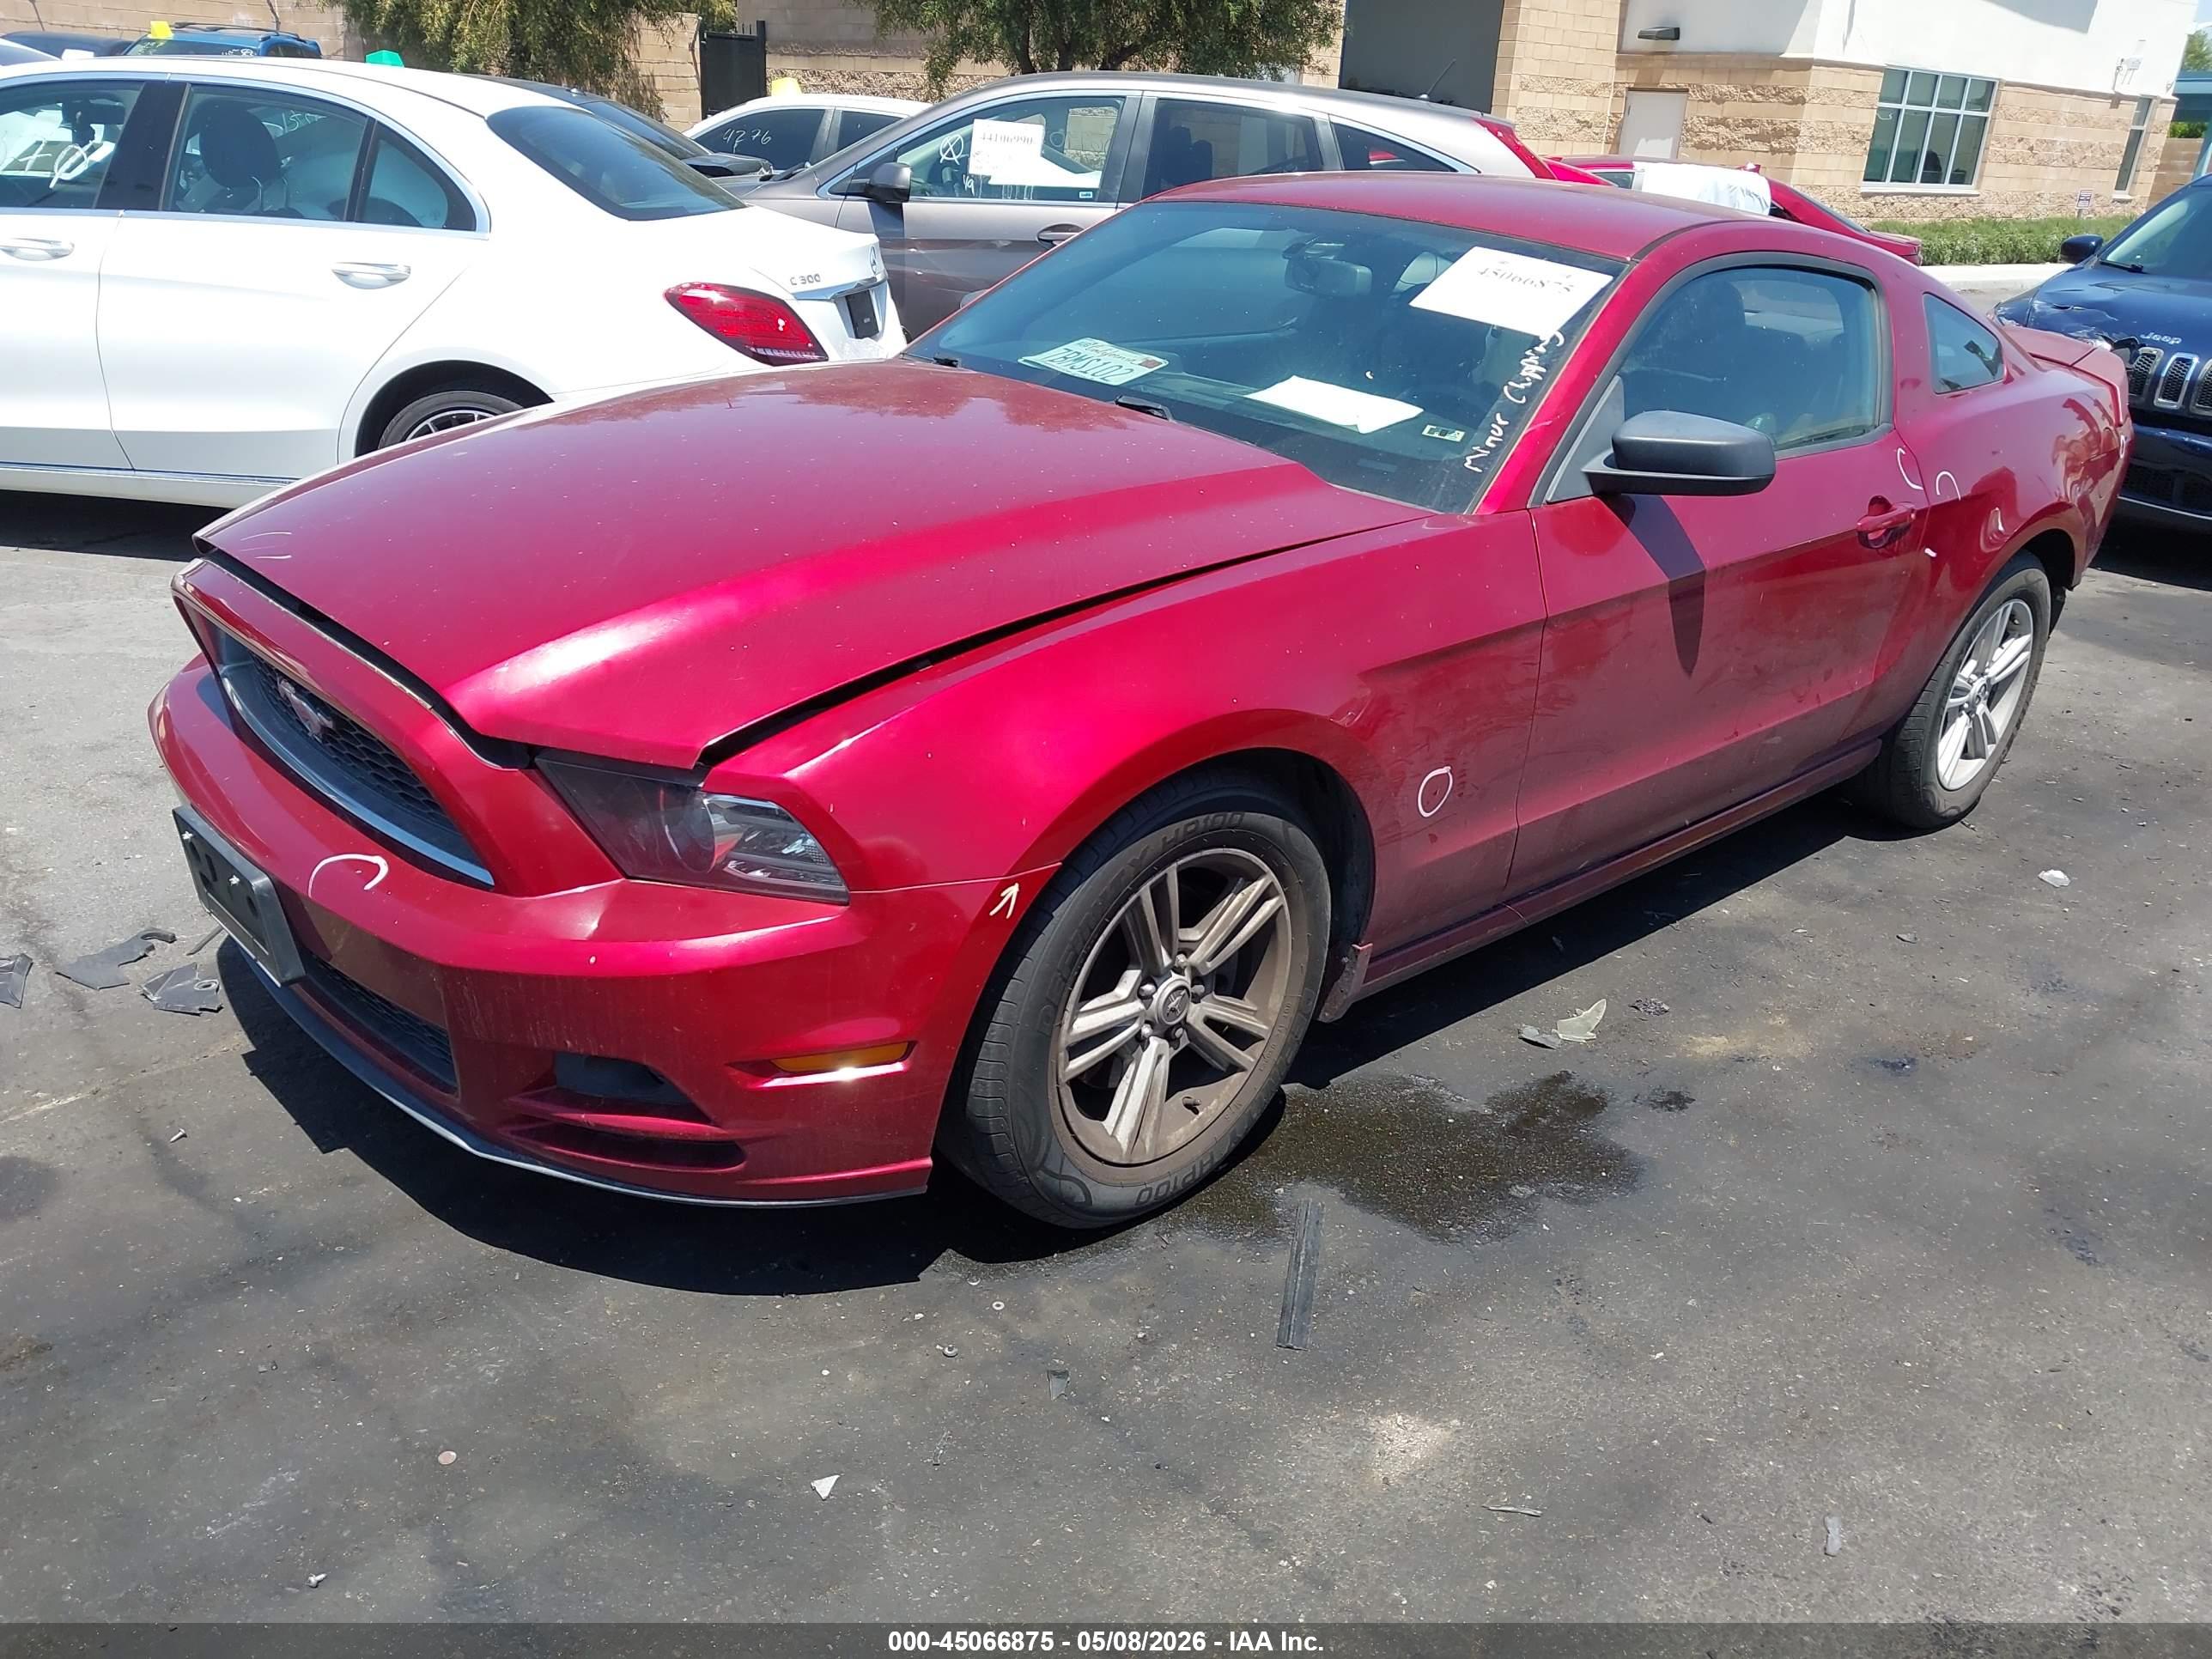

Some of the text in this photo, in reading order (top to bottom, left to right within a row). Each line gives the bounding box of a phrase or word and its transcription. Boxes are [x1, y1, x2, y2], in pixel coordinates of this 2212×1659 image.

[723, 128, 772, 146] 4276
[799, 273, 821, 285] 300
[2140, 331, 2182, 345] Jeep
[1038, 348, 1135, 382] 7BMS102
[1463, 412, 1510, 473] Minor
[1160, 811, 1245, 852] HP100
[1133, 1152, 1216, 1206] HP100
